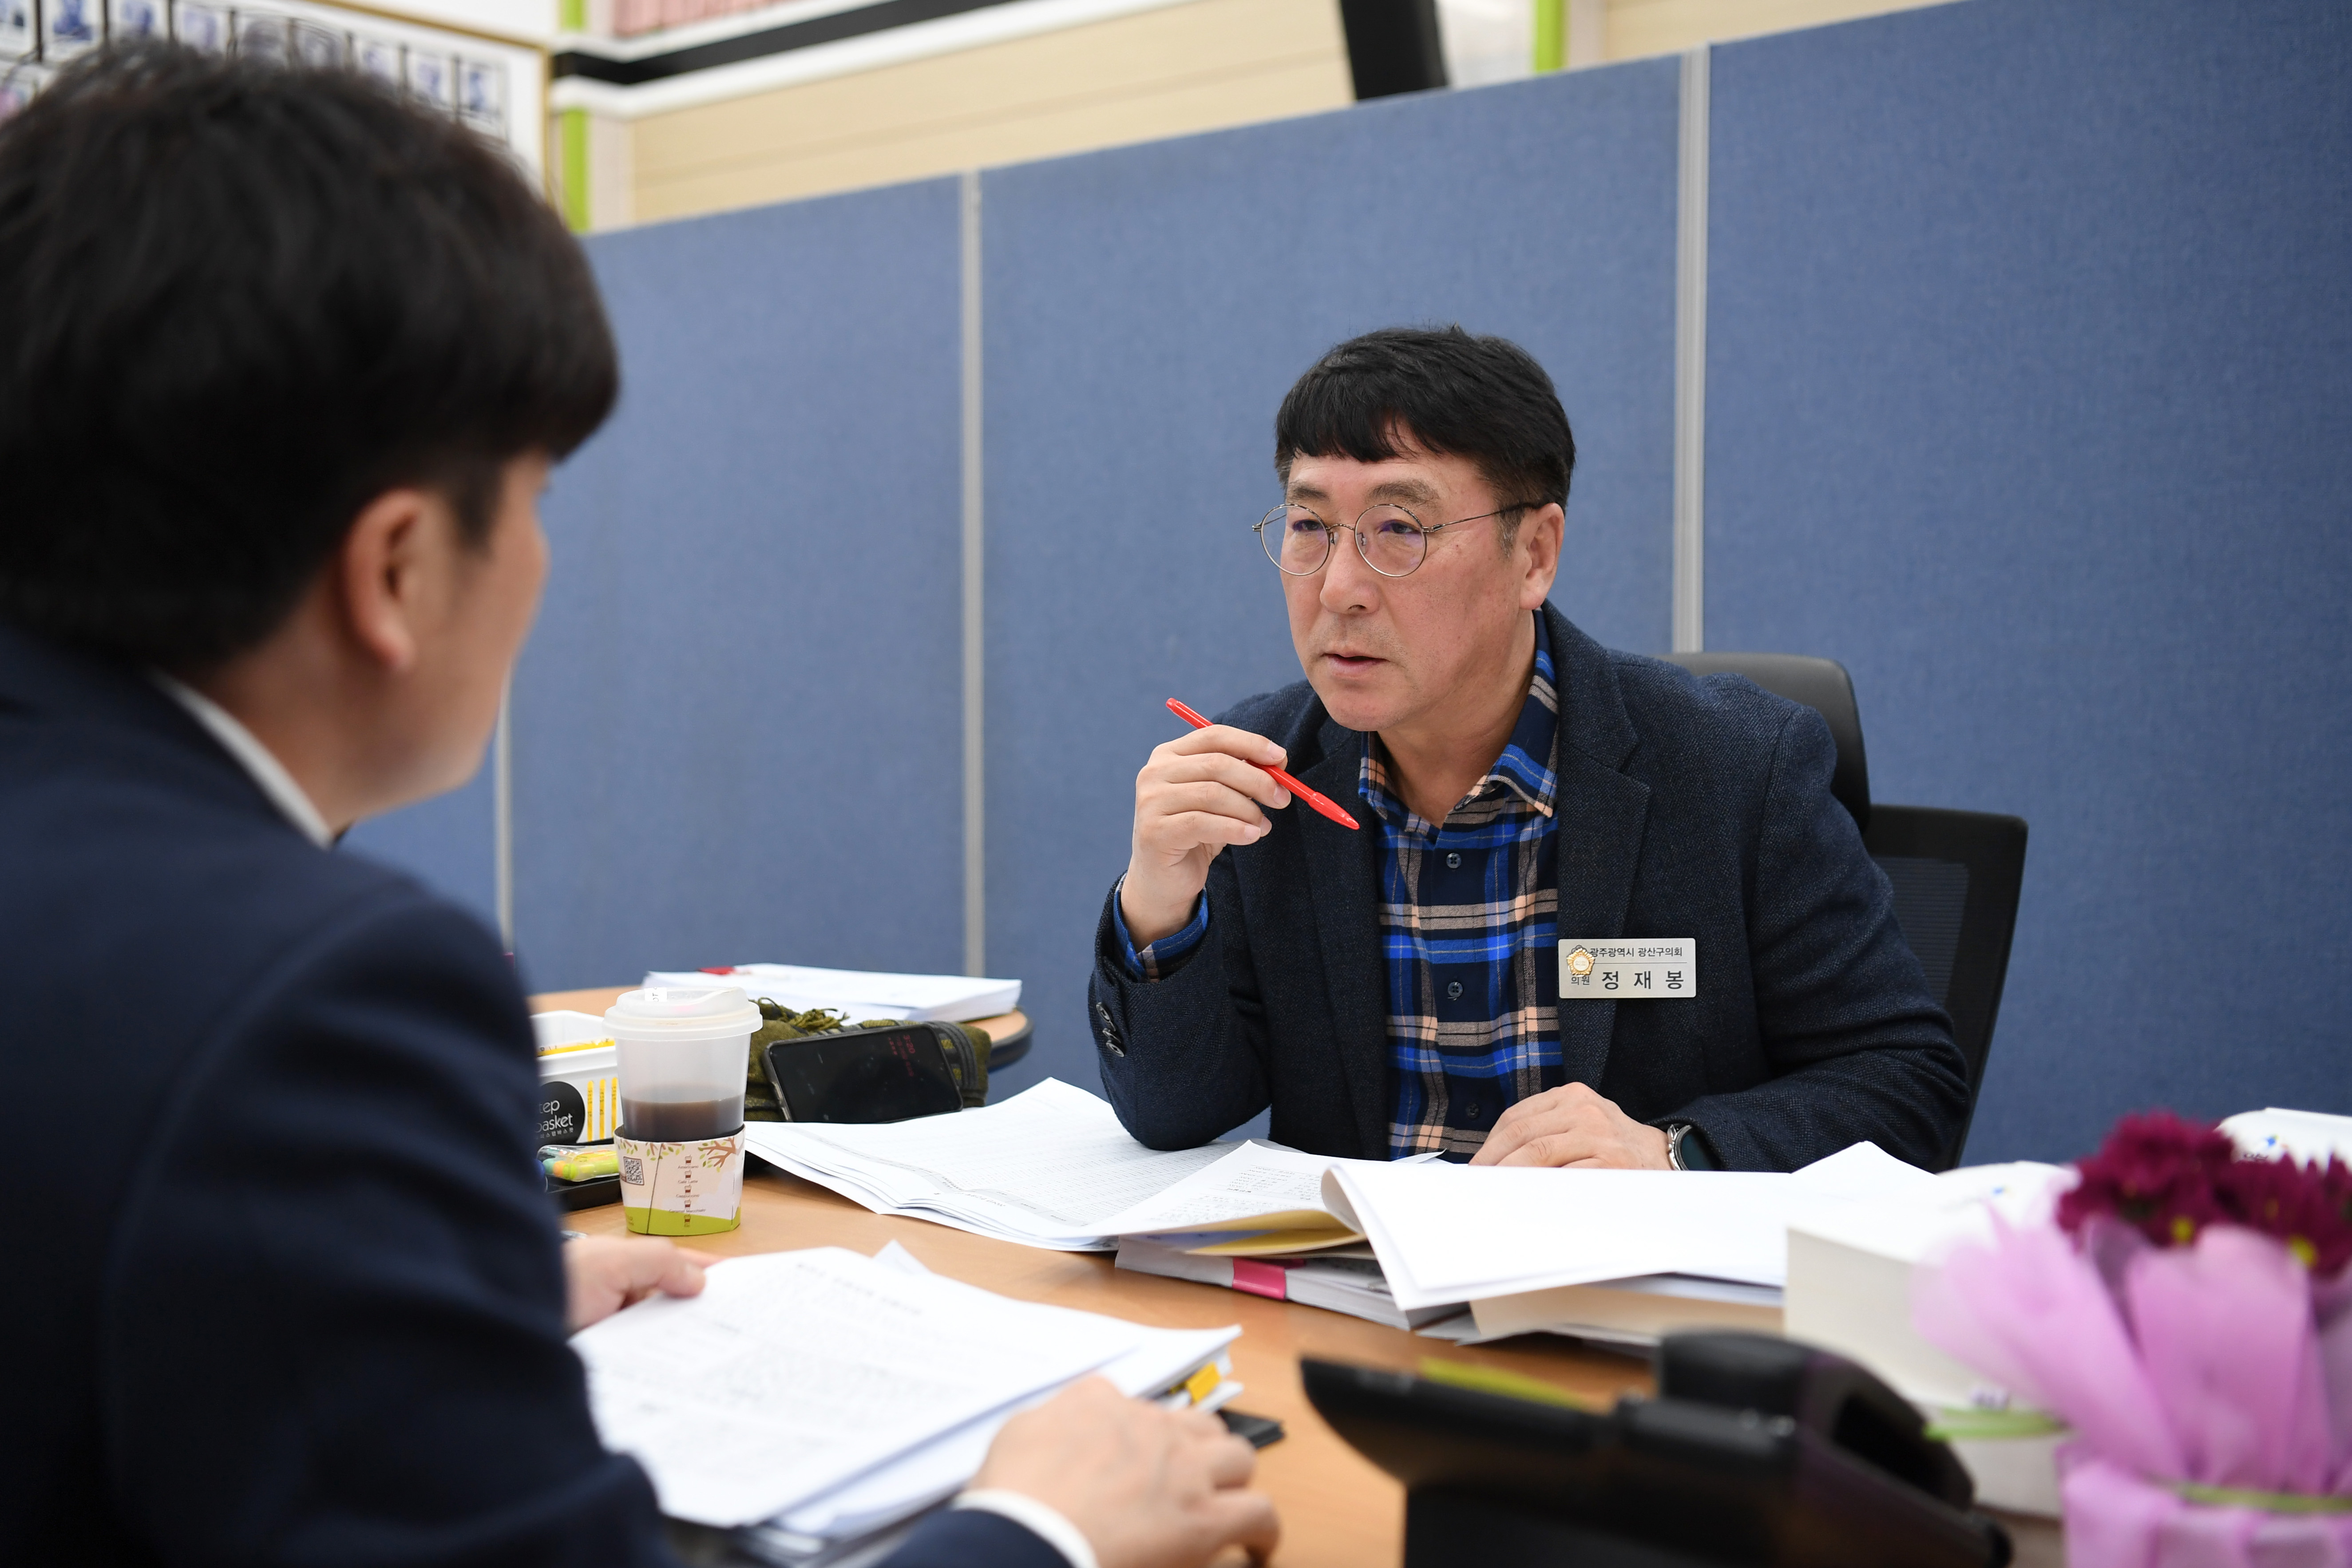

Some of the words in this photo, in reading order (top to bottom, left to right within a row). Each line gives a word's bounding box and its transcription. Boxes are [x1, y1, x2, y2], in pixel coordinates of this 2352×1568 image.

[1590, 947, 1634, 957] 광주광역시
[1638, 947, 1683, 957] 광산구의회
[1571, 976, 1590, 986] 의원
